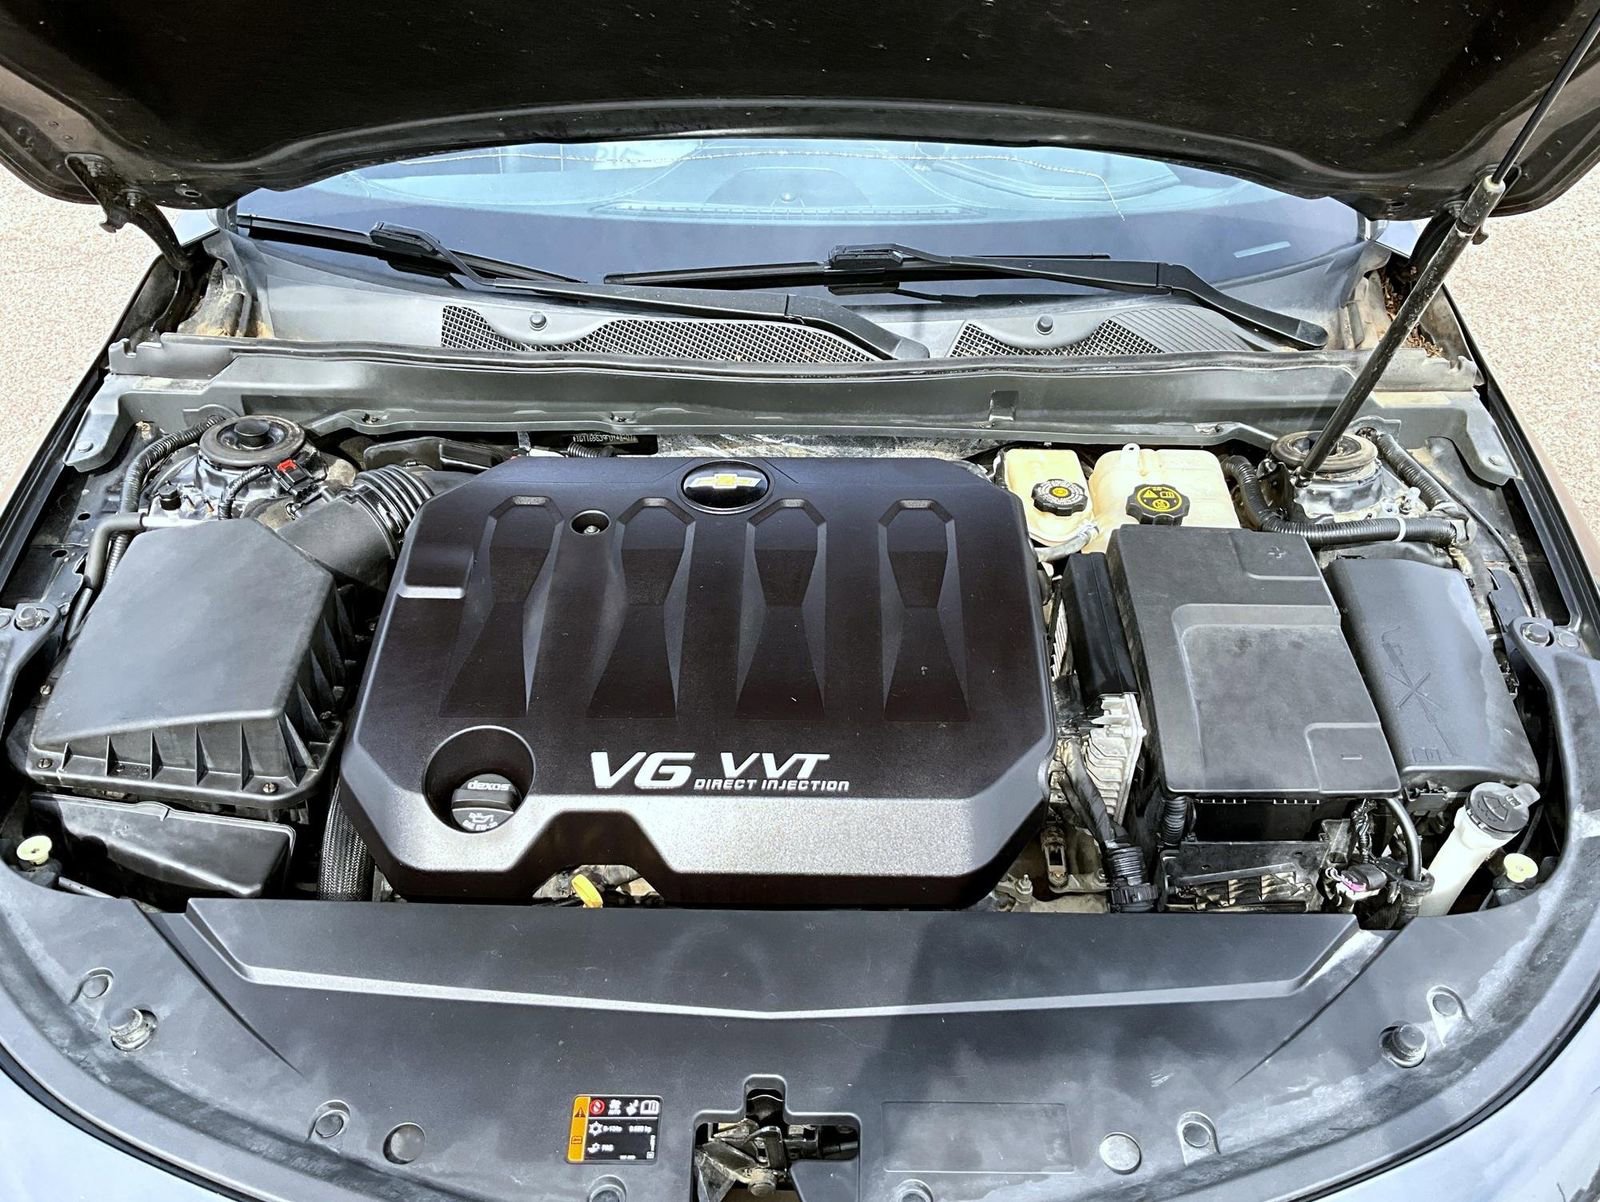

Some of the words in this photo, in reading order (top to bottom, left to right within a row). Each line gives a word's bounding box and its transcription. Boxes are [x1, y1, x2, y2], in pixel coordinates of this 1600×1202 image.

[591, 751, 696, 790] V6
[720, 752, 831, 779] VVT
[467, 780, 512, 791] dexos
[693, 779, 758, 791] DIRECT
[761, 779, 850, 792] INJECTION
